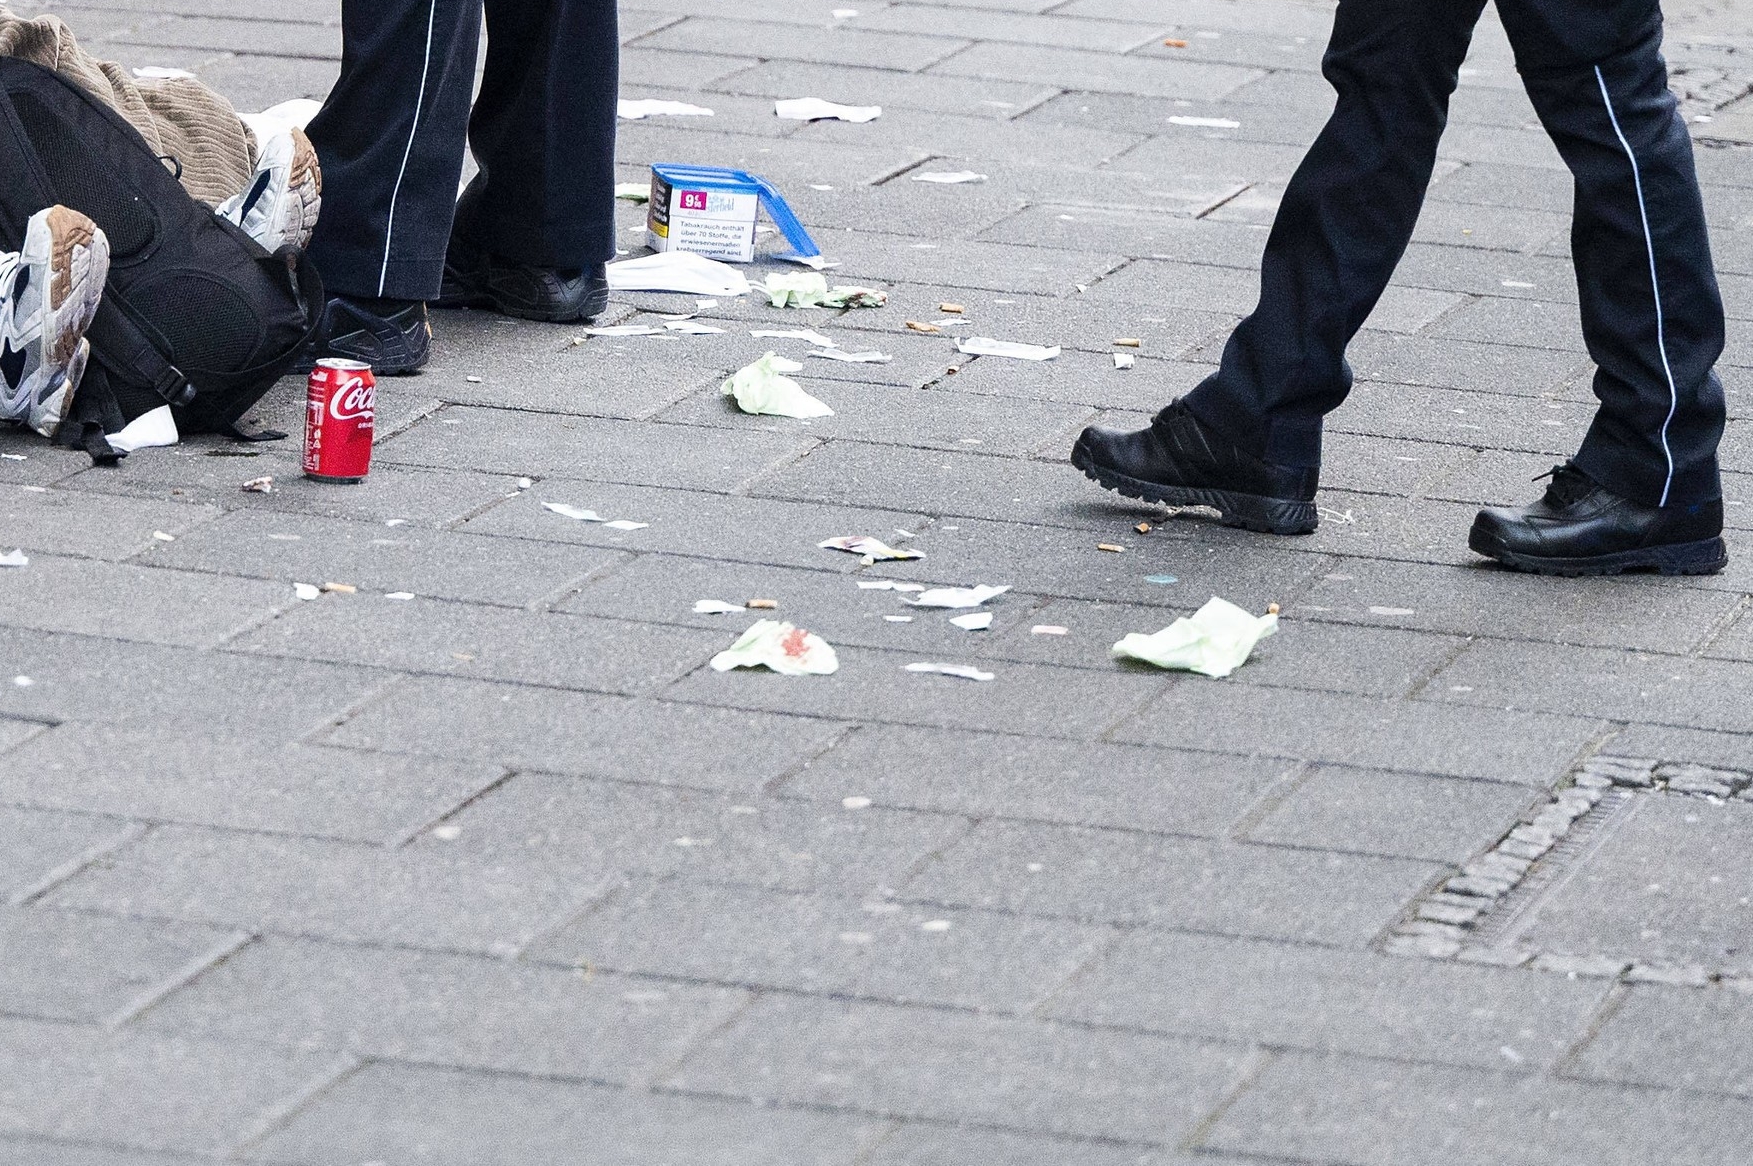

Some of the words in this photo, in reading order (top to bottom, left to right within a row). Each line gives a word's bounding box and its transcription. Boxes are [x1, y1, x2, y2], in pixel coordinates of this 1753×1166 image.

[680, 221, 720, 230] Tabakrauch
[721, 224, 745, 232] enthält
[680, 238, 741, 248] erwiesenermaßen
[676, 246, 726, 256] krebserregend
